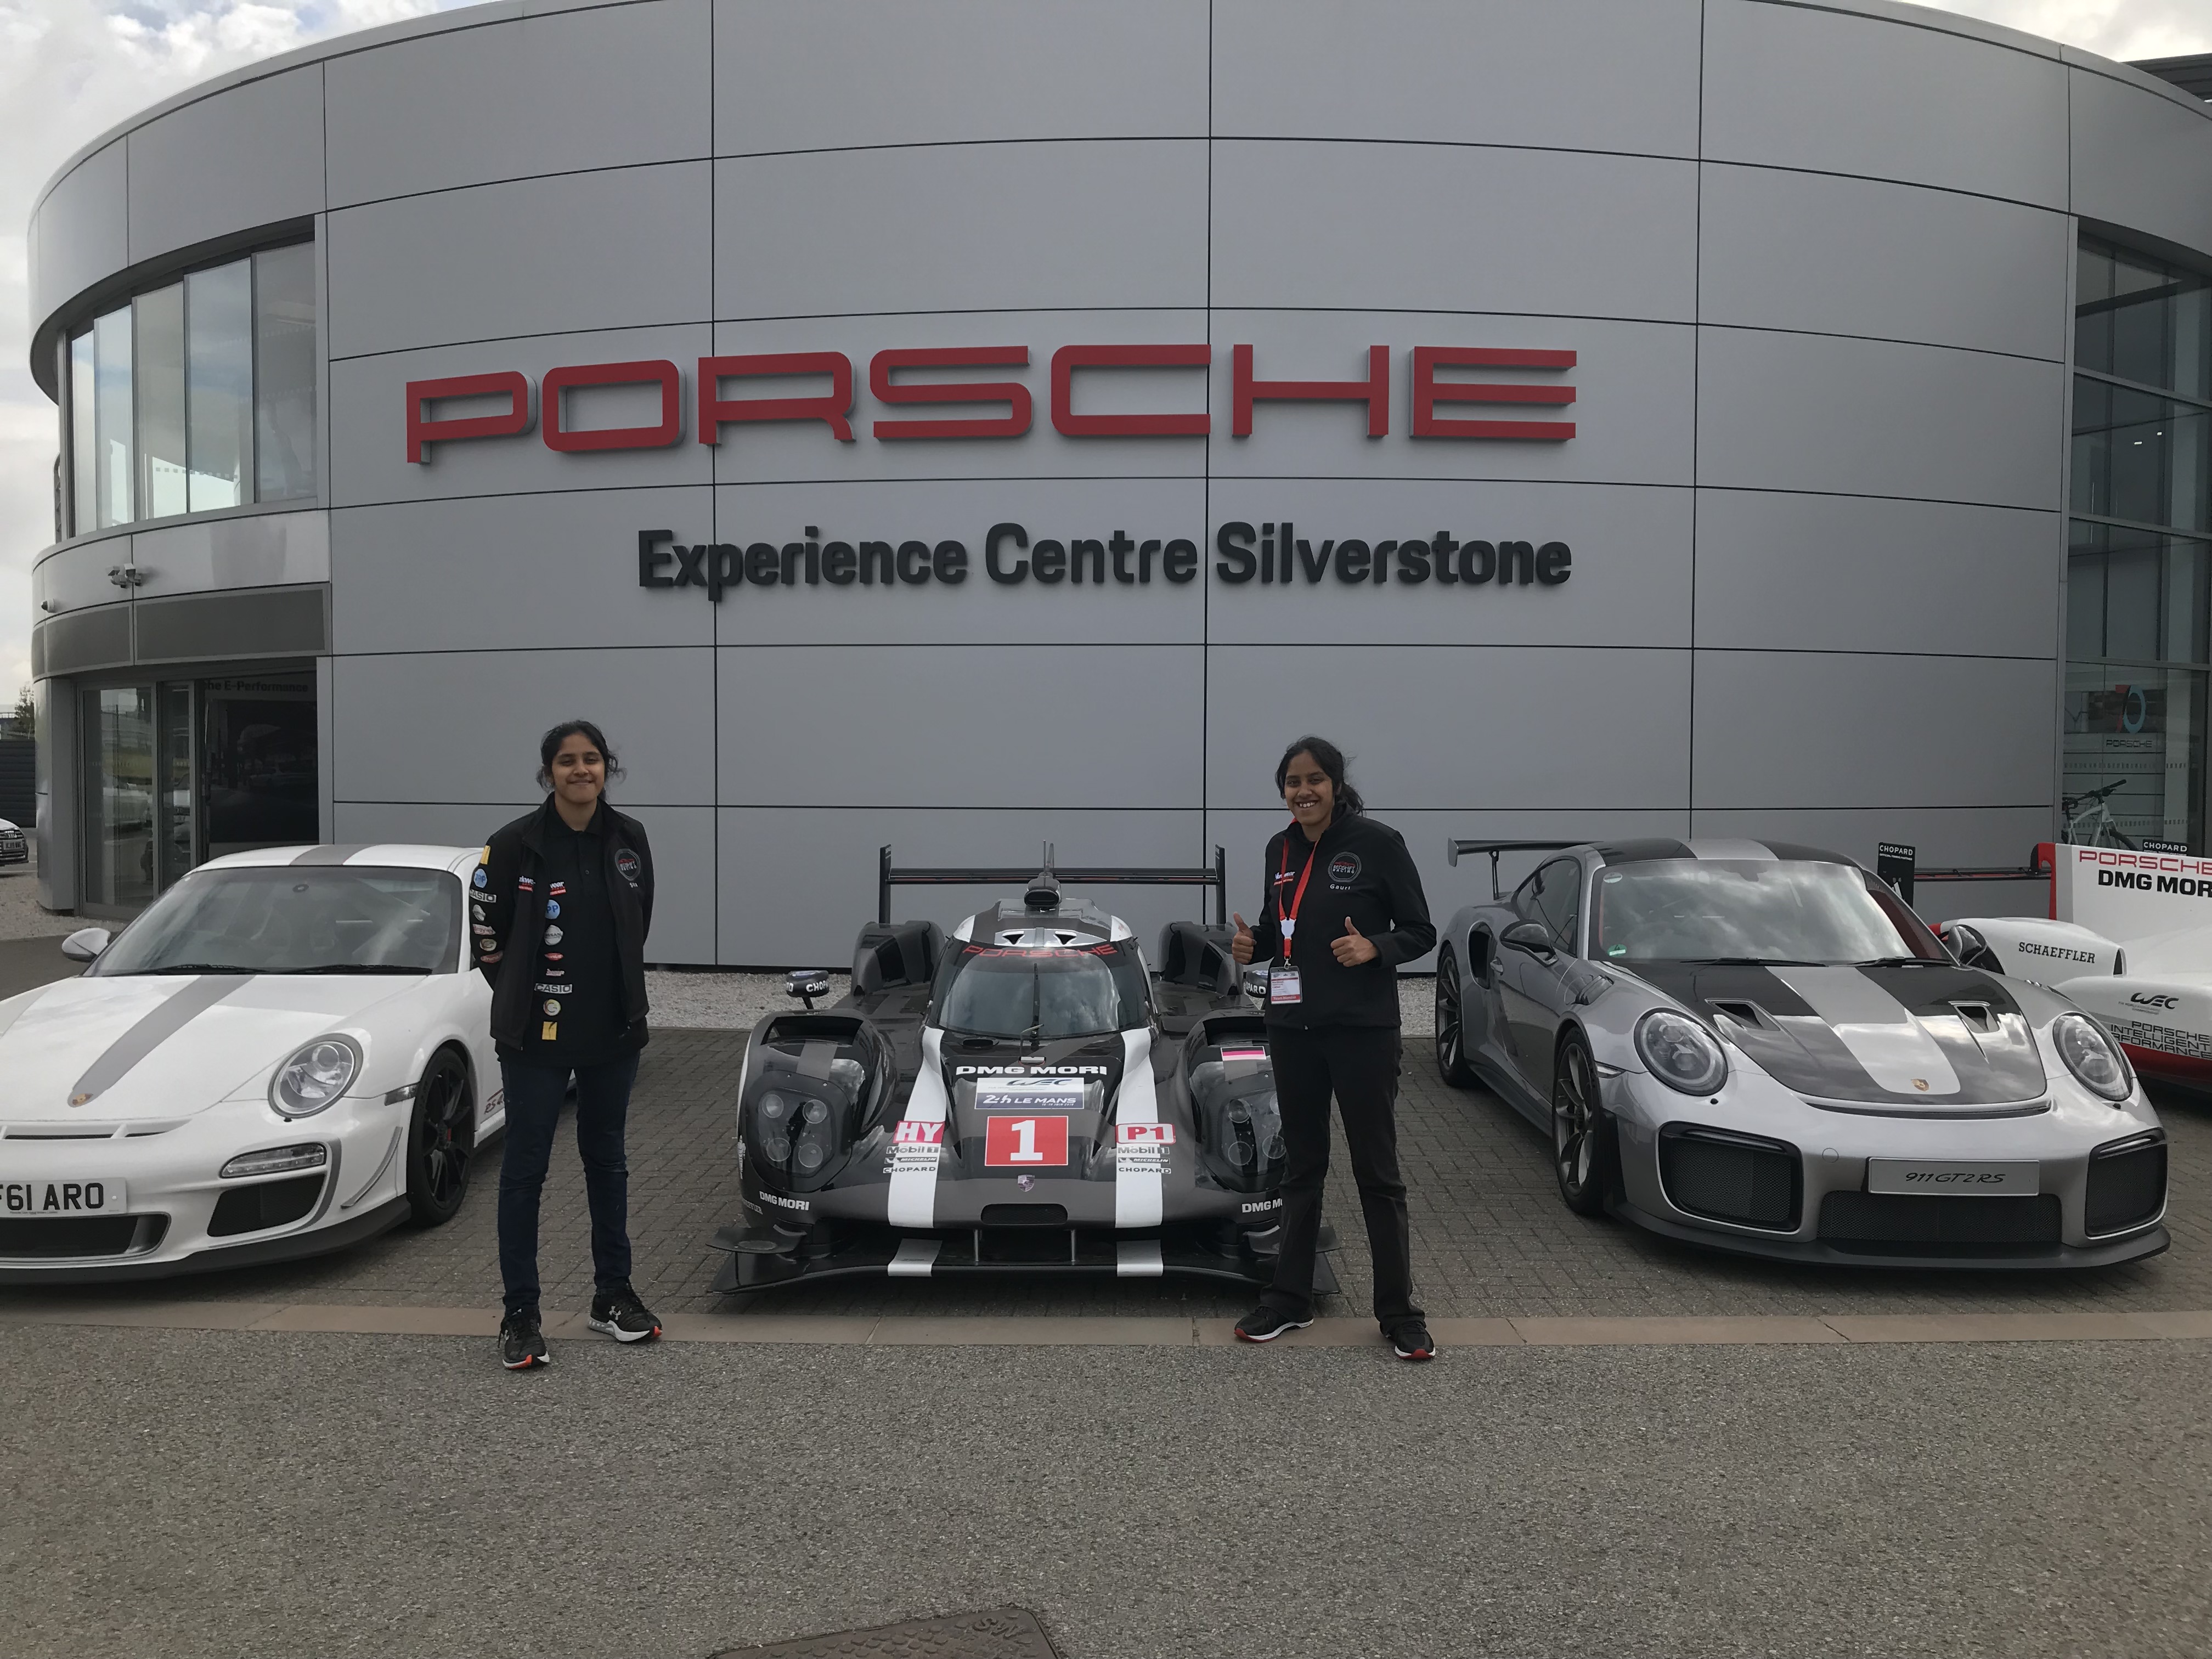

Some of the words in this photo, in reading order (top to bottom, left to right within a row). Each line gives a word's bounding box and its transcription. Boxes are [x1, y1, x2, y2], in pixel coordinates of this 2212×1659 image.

[407, 345, 1576, 463] PORSCHE
[638, 526, 968, 602] Experience
[985, 522, 1198, 585] Centre
[1216, 521, 1572, 586] Silverstone
[2106, 740, 2153, 748] PORSCHE
[1880, 845, 1913, 855] CHOPARD
[2143, 842, 2187, 852] CHOPARD
[2079, 850, 2212, 875] PORSCHE
[2098, 869, 2152, 890] DMG
[962, 944, 1118, 957] PORSCHE
[2018, 941, 2096, 964] SCHAEFFLER
[535, 984, 571, 993] CASIO
[2130, 992, 2179, 1009] WEC
[2111, 1024, 2210, 1051] INTELLIGENT
[2132, 1021, 2210, 1043] PORSCHE
[956, 1066, 1025, 1075] DMG
[1030, 1066, 1107, 1075] MORI
[895, 1122, 943, 1142] HY
[1010, 1120, 1043, 1161] 1
[1127, 1126, 1165, 1140] P1
[1118, 1146, 1155, 1154] Mobil
[0, 1183, 32, 1211] 61
[43, 1182, 104, 1211] ARO
[759, 1190, 777, 1205] DMG
[777, 1197, 810, 1211] MORI
[1242, 1200, 1271, 1213] DMG
[1272, 1198, 1283, 1209] M
